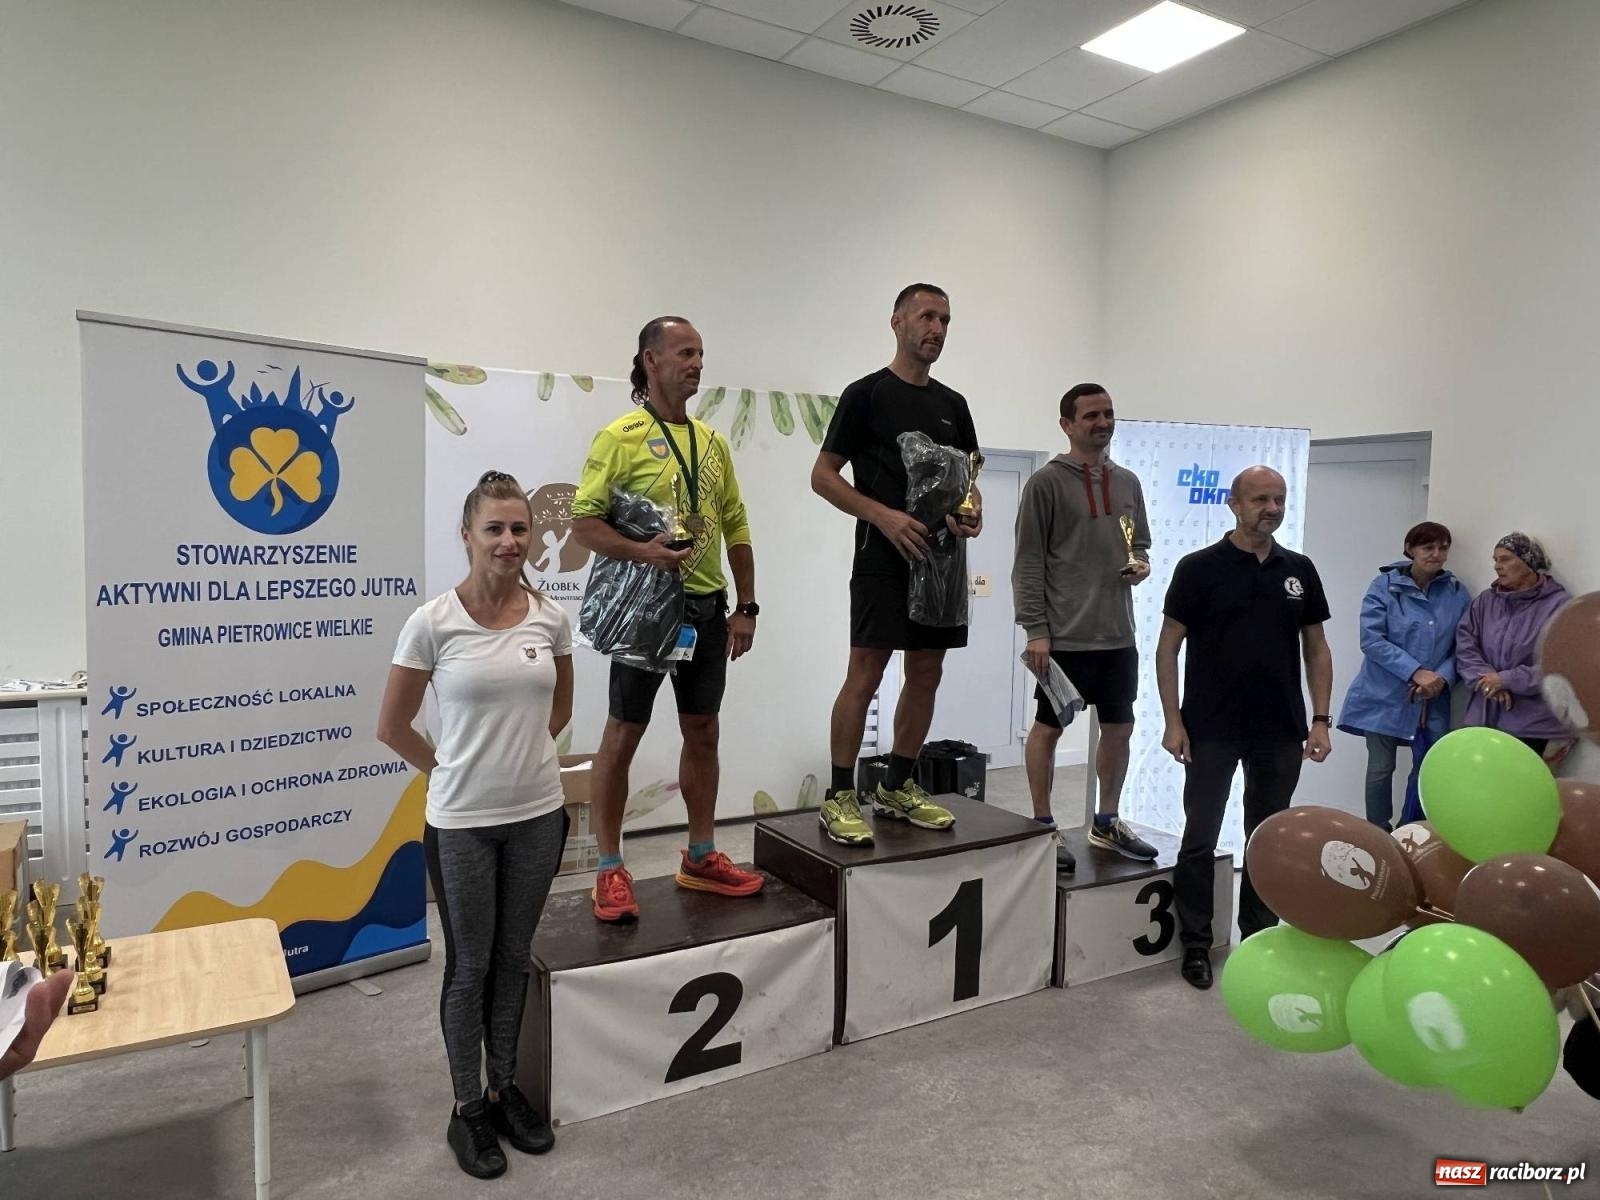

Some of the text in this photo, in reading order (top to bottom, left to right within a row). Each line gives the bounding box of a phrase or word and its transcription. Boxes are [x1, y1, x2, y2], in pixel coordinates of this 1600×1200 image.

[1177, 463, 1220, 487] eko
[1189, 487, 1232, 505] okn
[176, 544, 358, 566] STOWARZYSZENIE
[96, 577, 417, 606] AKTYWNI DLA LEPSZEGO JUTRA
[158, 617, 373, 648] GMINA PIETROWICE WIELKIE
[136, 684, 357, 718] SPOŁECZNOŚĆ LOKALNA
[137, 725, 353, 765] KULTURA I DZIEDZICTWO
[138, 760, 408, 812] EKOLOGIA I OCHRONA ZDROWIA
[139, 808, 353, 858] ROZWÓJ GOSPODARCZY
[1132, 879, 1176, 957] 3
[928, 877, 984, 1003] 1
[663, 971, 744, 1084] 2
